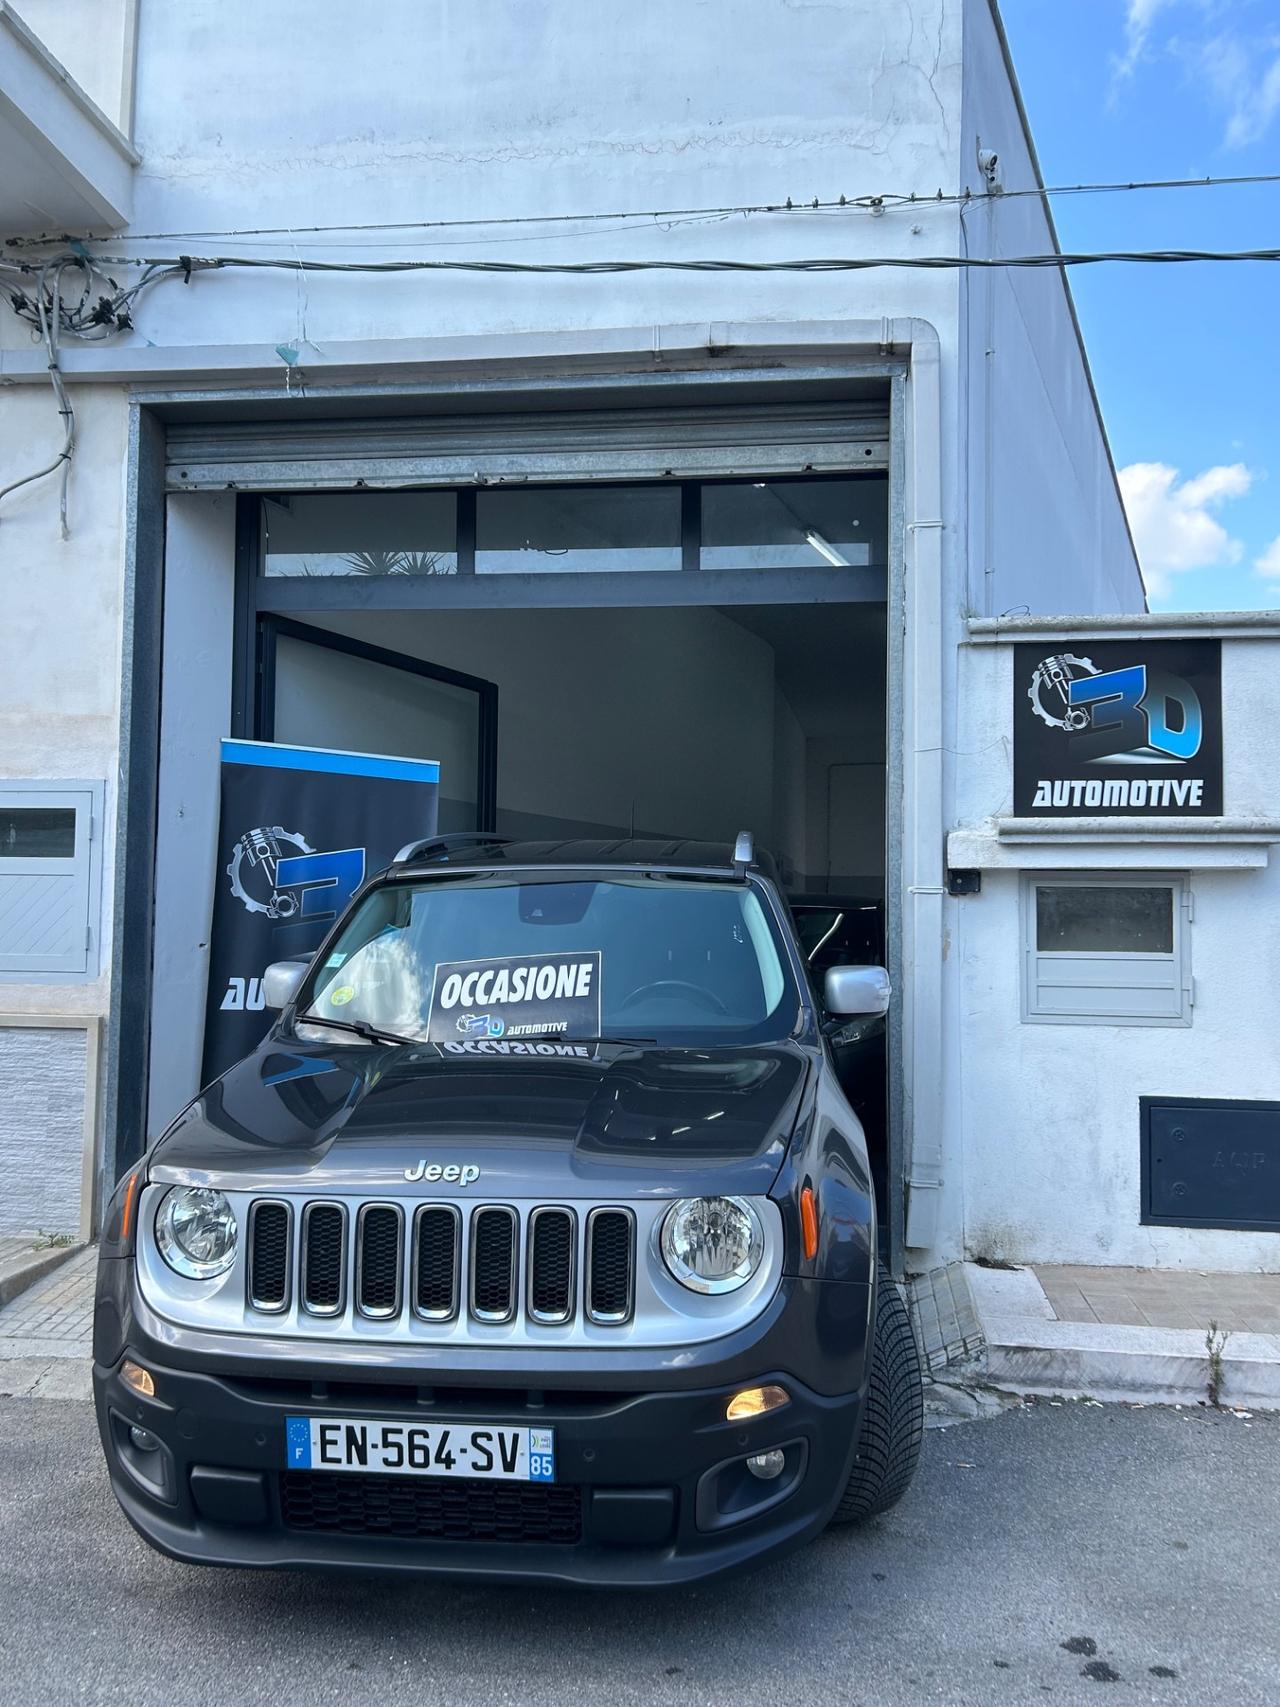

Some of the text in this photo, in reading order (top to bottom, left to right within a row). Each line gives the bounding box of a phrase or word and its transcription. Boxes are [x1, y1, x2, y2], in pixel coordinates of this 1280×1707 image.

[1032, 779, 1204, 807] AUTOMOTIVE
[440, 963, 593, 1009] OCCASIONE
[507, 1021, 568, 1036] AUTOMOTIVE
[404, 1159, 480, 1186] Jeep
[295, 1424, 520, 1473] F EN-564-SV
[530, 1455, 553, 1476] 85
